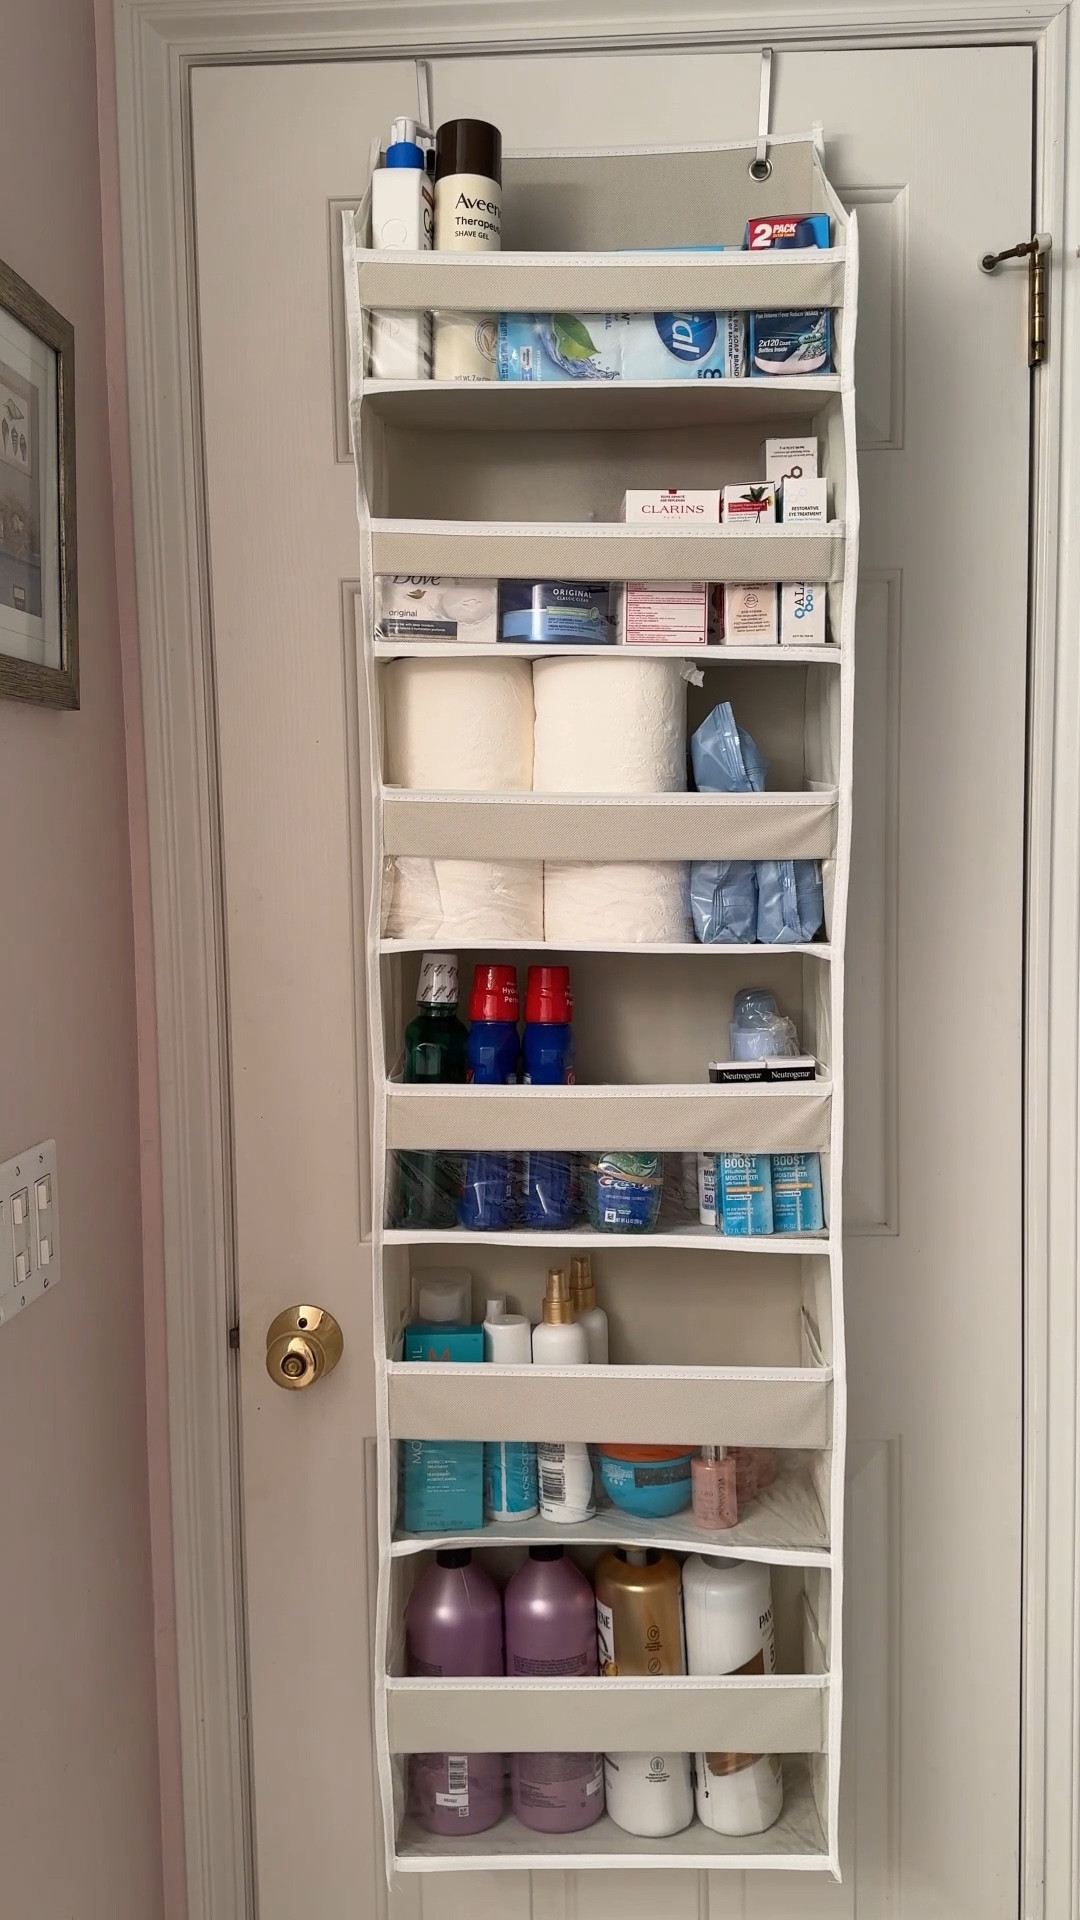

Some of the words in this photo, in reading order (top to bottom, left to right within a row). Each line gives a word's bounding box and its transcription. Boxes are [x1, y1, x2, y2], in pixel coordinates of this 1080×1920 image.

[455, 192, 501, 219] Aveen
[455, 216, 501, 235] Therapeu
[455, 230, 477, 238] SHAVE
[478, 231, 490, 241] GEL
[752, 223, 773, 247] 2
[773, 223, 797, 234] PACK
[758, 339, 779, 347] 2x120
[641, 504, 705, 514] CLARINS
[552, 588, 592, 599] ORIGINAL
[795, 582, 805, 607] ALA
[388, 609, 418, 618] original
[722, 1072, 762, 1081] Neutrogena
[771, 1070, 810, 1079] Neutrogena
[724, 1157, 757, 1169] BOOST
[773, 1155, 806, 1166] BOOST
[704, 1194, 714, 1204] 50
[759, 1608, 772, 1630] PAN
